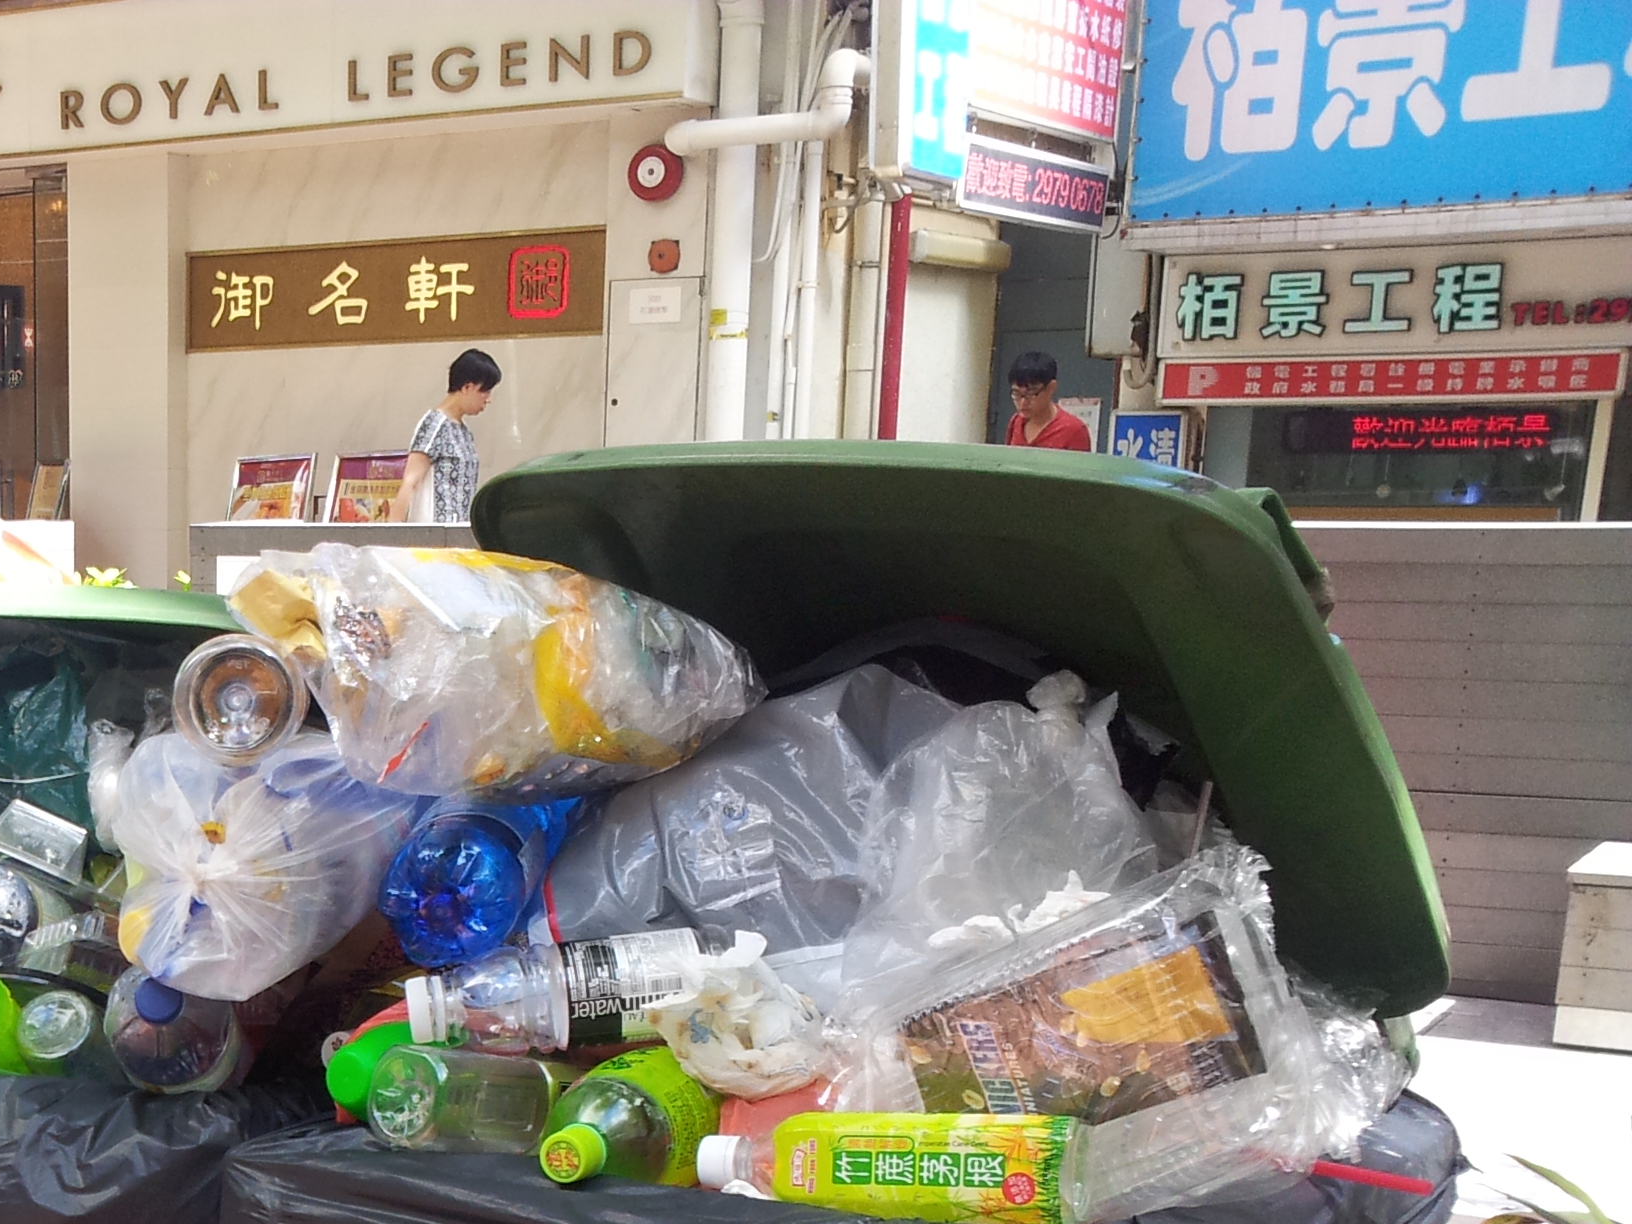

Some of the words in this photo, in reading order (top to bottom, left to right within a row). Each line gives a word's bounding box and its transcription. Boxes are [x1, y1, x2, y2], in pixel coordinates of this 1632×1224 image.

[60, 69, 279, 130] ROYAL
[348, 30, 652, 102] LEGEND
[1033, 168, 1069, 208] 2979
[211, 255, 475, 331] 御名軒
[1176, 262, 1504, 341] 栢景工程
[834, 1152, 1005, 1187] 竹蔗茅根
